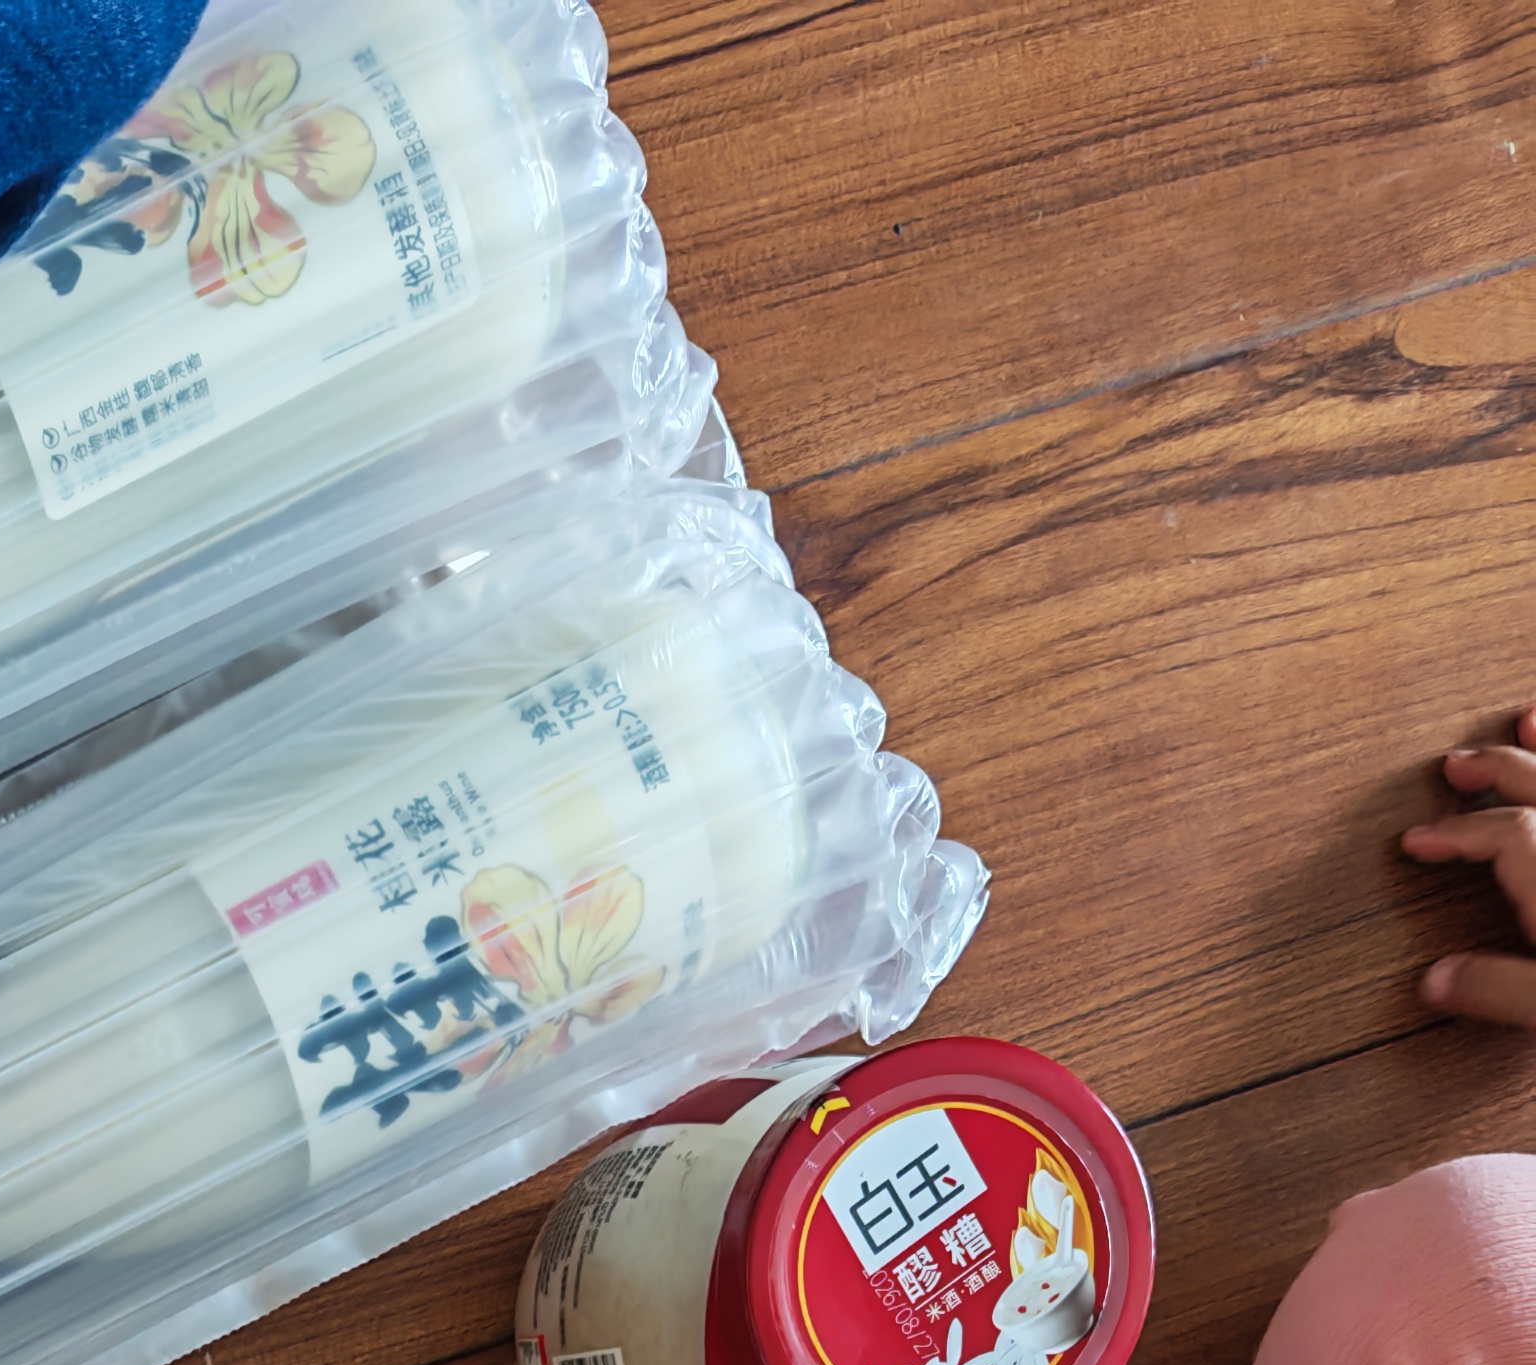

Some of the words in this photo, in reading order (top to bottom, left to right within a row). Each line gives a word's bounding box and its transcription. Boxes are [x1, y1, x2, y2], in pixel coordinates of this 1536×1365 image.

[375, 170, 445, 318] 其他发酵酒
[58, 387, 135, 437] 广西金桂
[454, 768, 482, 805] Wine
[341, 814, 422, 919] 桂花
[389, 790, 468, 892] 米露
[846, 1143, 964, 1255] 白玉
[891, 1209, 993, 1303] 醪糟
